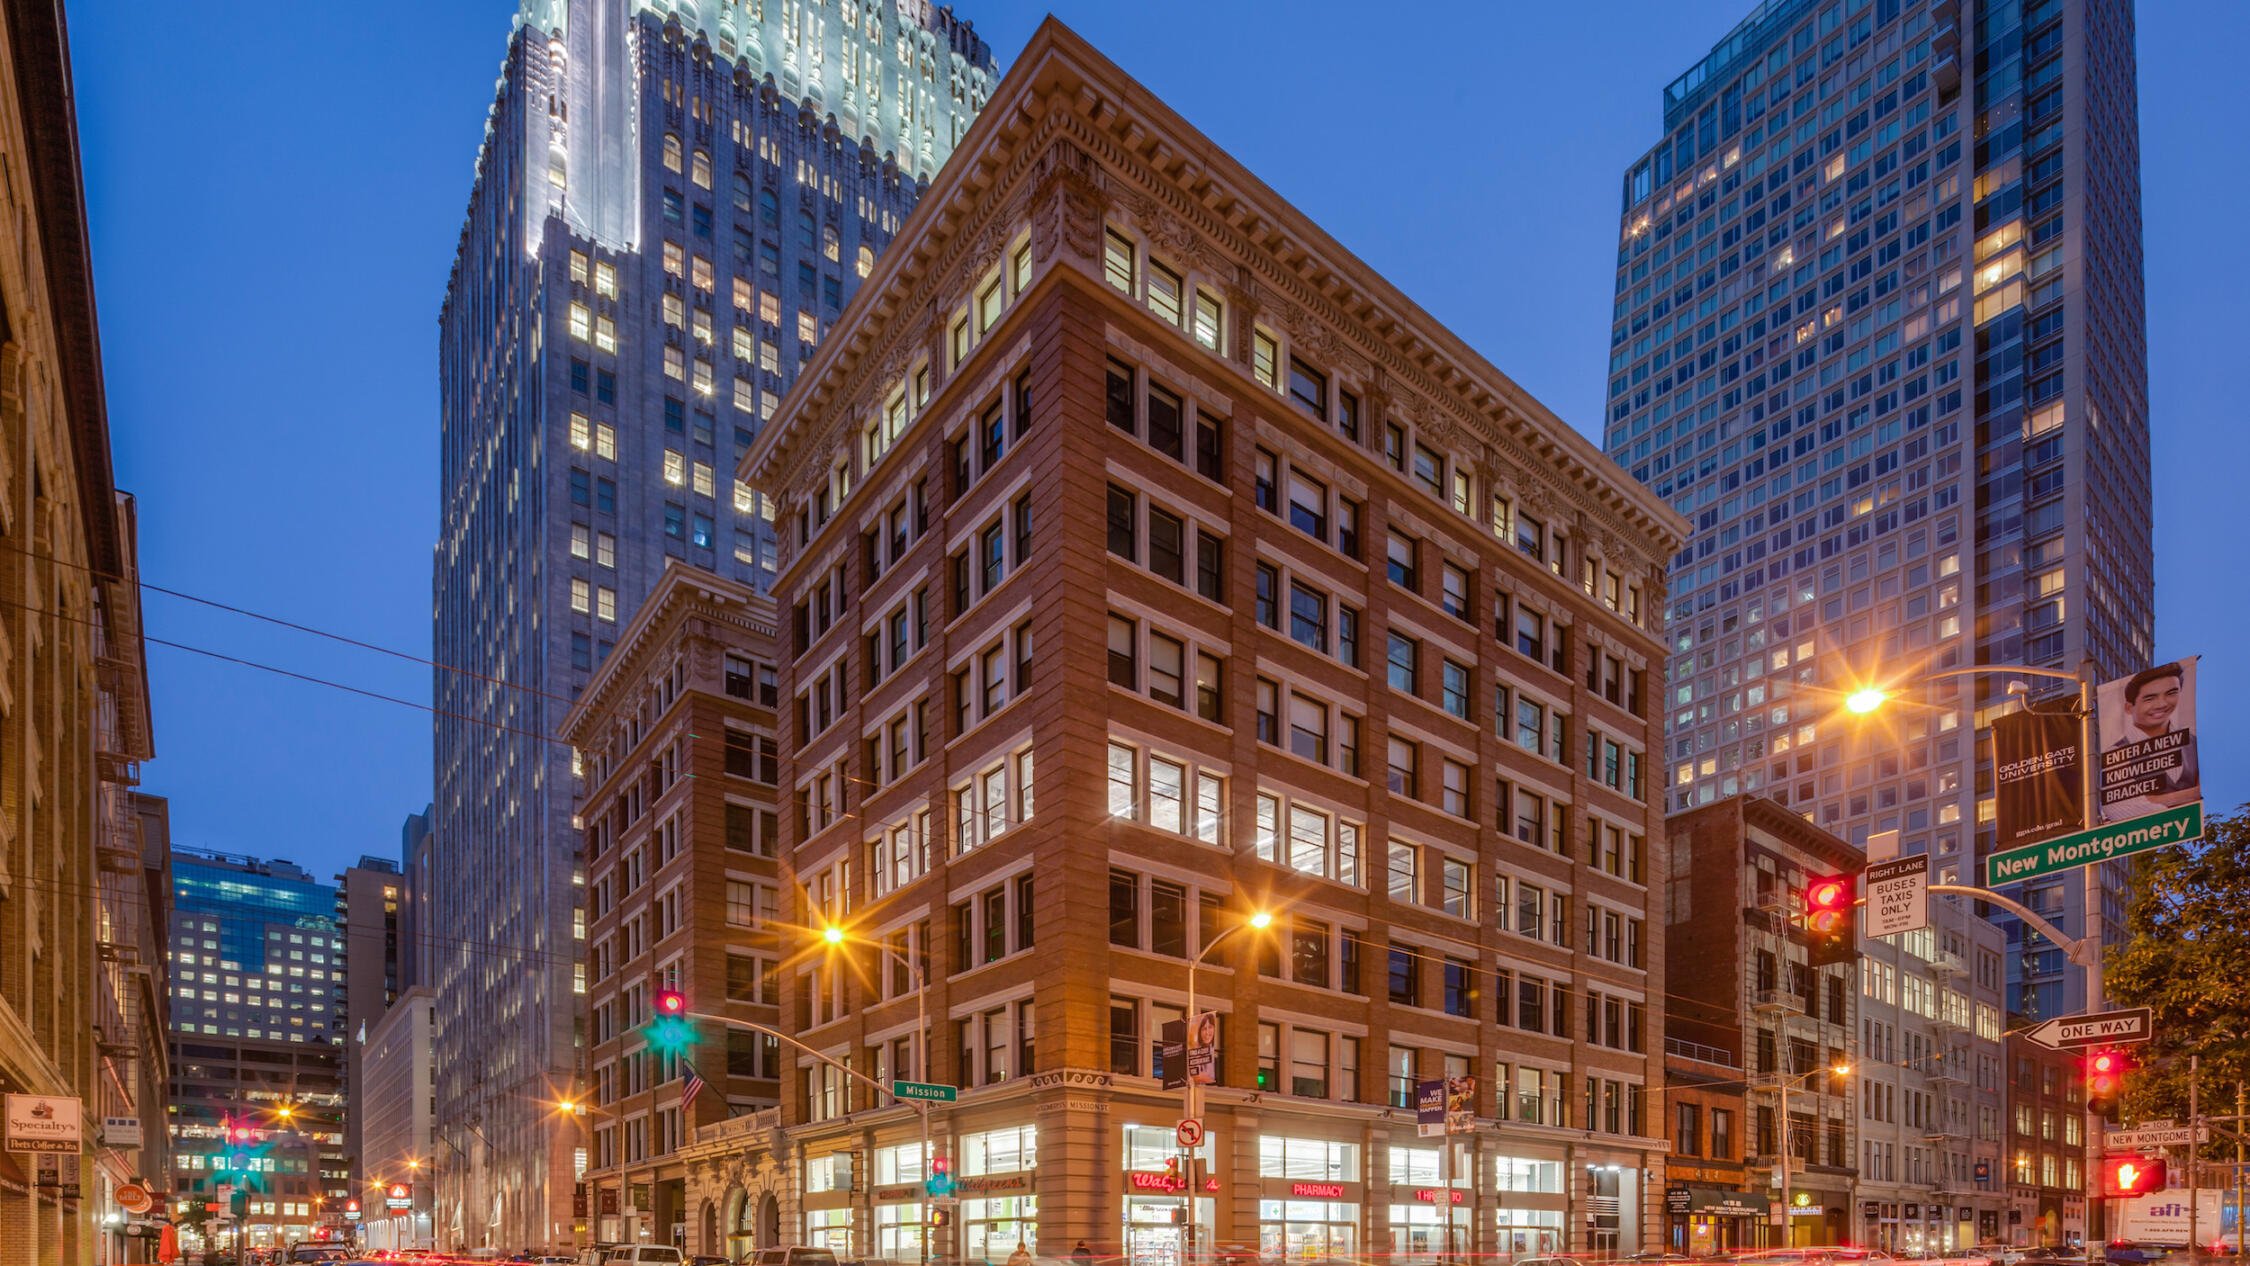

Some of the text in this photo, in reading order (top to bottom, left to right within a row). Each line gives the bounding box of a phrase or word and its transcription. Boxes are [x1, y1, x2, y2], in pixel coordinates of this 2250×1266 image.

[2106, 732, 2183, 765] ENTER A NEW
[1999, 745, 2075, 773] GOLDEN GATE
[1999, 753, 2076, 780] UNIVERSITY
[2106, 754, 2175, 784] KNOWLEDGE
[2106, 778, 2159, 802] BRACKET.
[1996, 815, 2190, 878] New Montgomery
[1869, 860, 1925, 880] RIGHT LANE
[1876, 878, 1916, 895] BUSES
[1880, 890, 1913, 905] TAXIS
[1881, 902, 1911, 916] ONLY
[2060, 1019, 2136, 1039] ONE WAY
[906, 1085, 945, 1099] Mission
[1430, 1088, 1443, 1097] WE
[1070, 1101, 1100, 1110] MISSION
[1420, 1096, 1443, 1105] MAKE
[11, 1119, 76, 1132] Specialty's
[2112, 1130, 2203, 1144] NEW MONTGOMEY
[64, 1141, 77, 1151] Tea
[1293, 1183, 1344, 1197] PHARMACY
